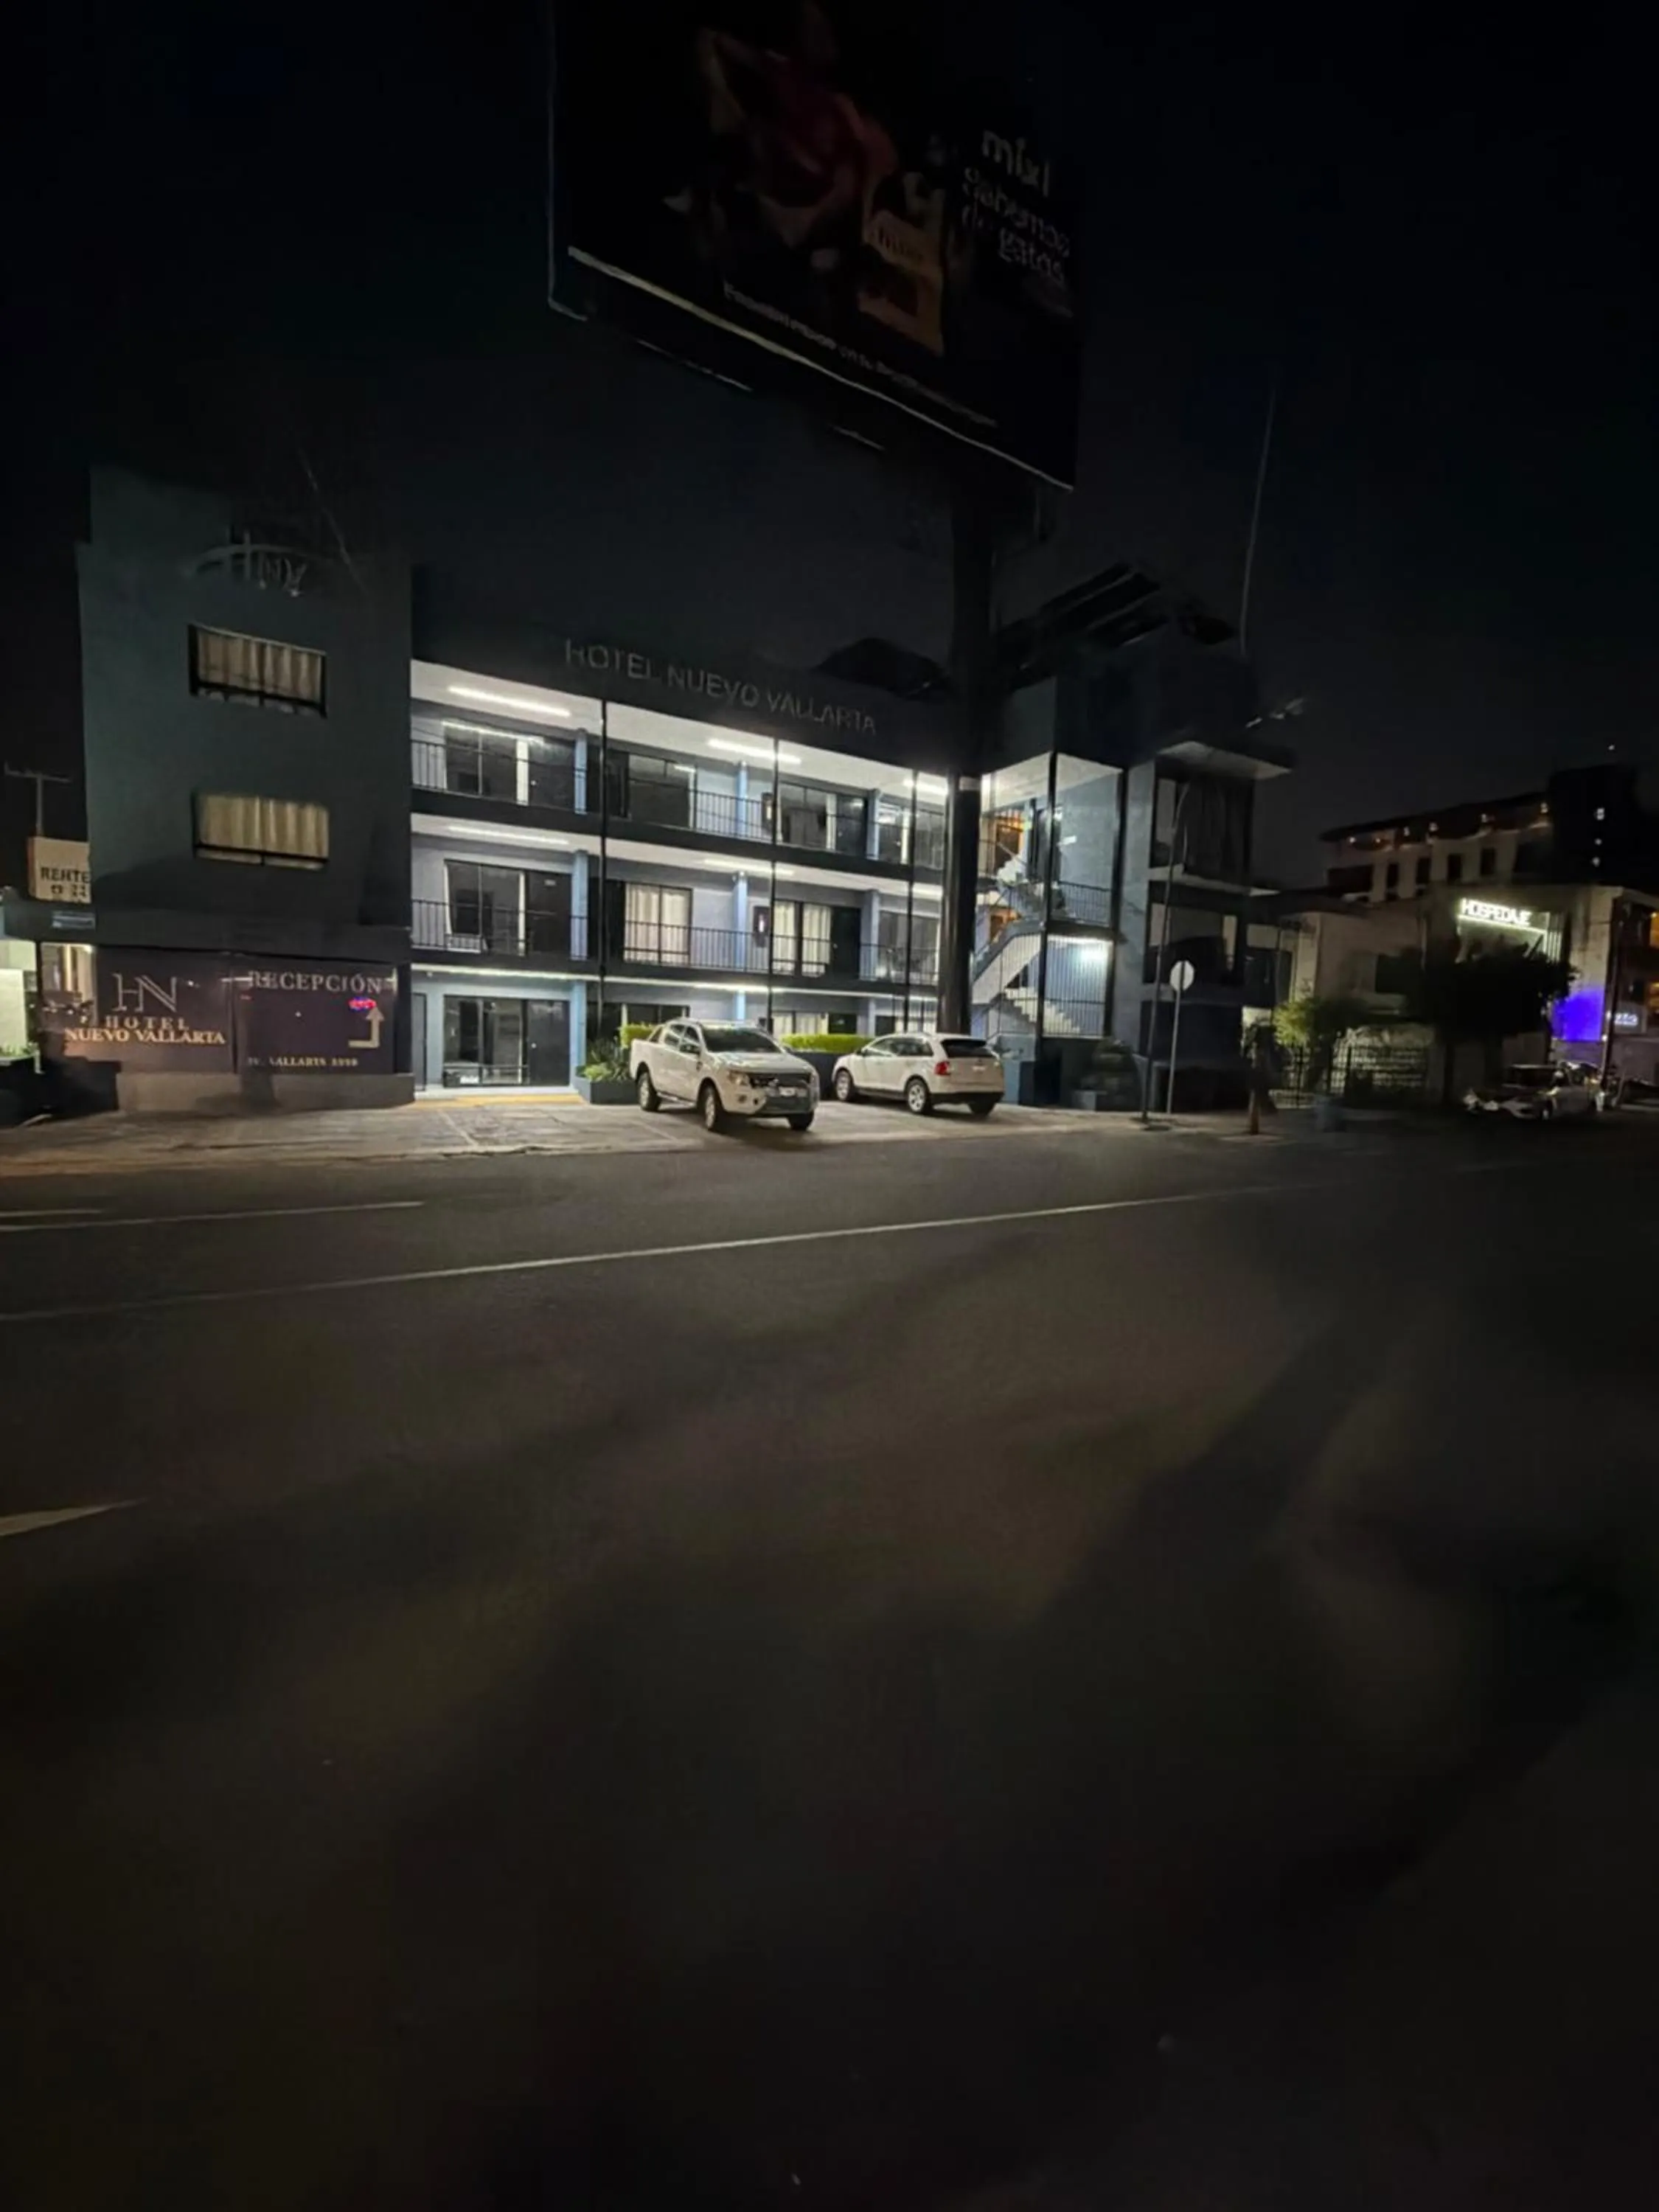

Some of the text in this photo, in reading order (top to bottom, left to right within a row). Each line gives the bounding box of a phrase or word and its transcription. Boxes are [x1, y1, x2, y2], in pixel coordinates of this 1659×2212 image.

[565, 637, 877, 737] HOTEL NUEVO VALLARTA
[248, 969, 383, 995] RECEPCIÓN
[105, 1015, 190, 1031] HOTEL
[64, 1028, 227, 1045] NUEVO VALLARTA
